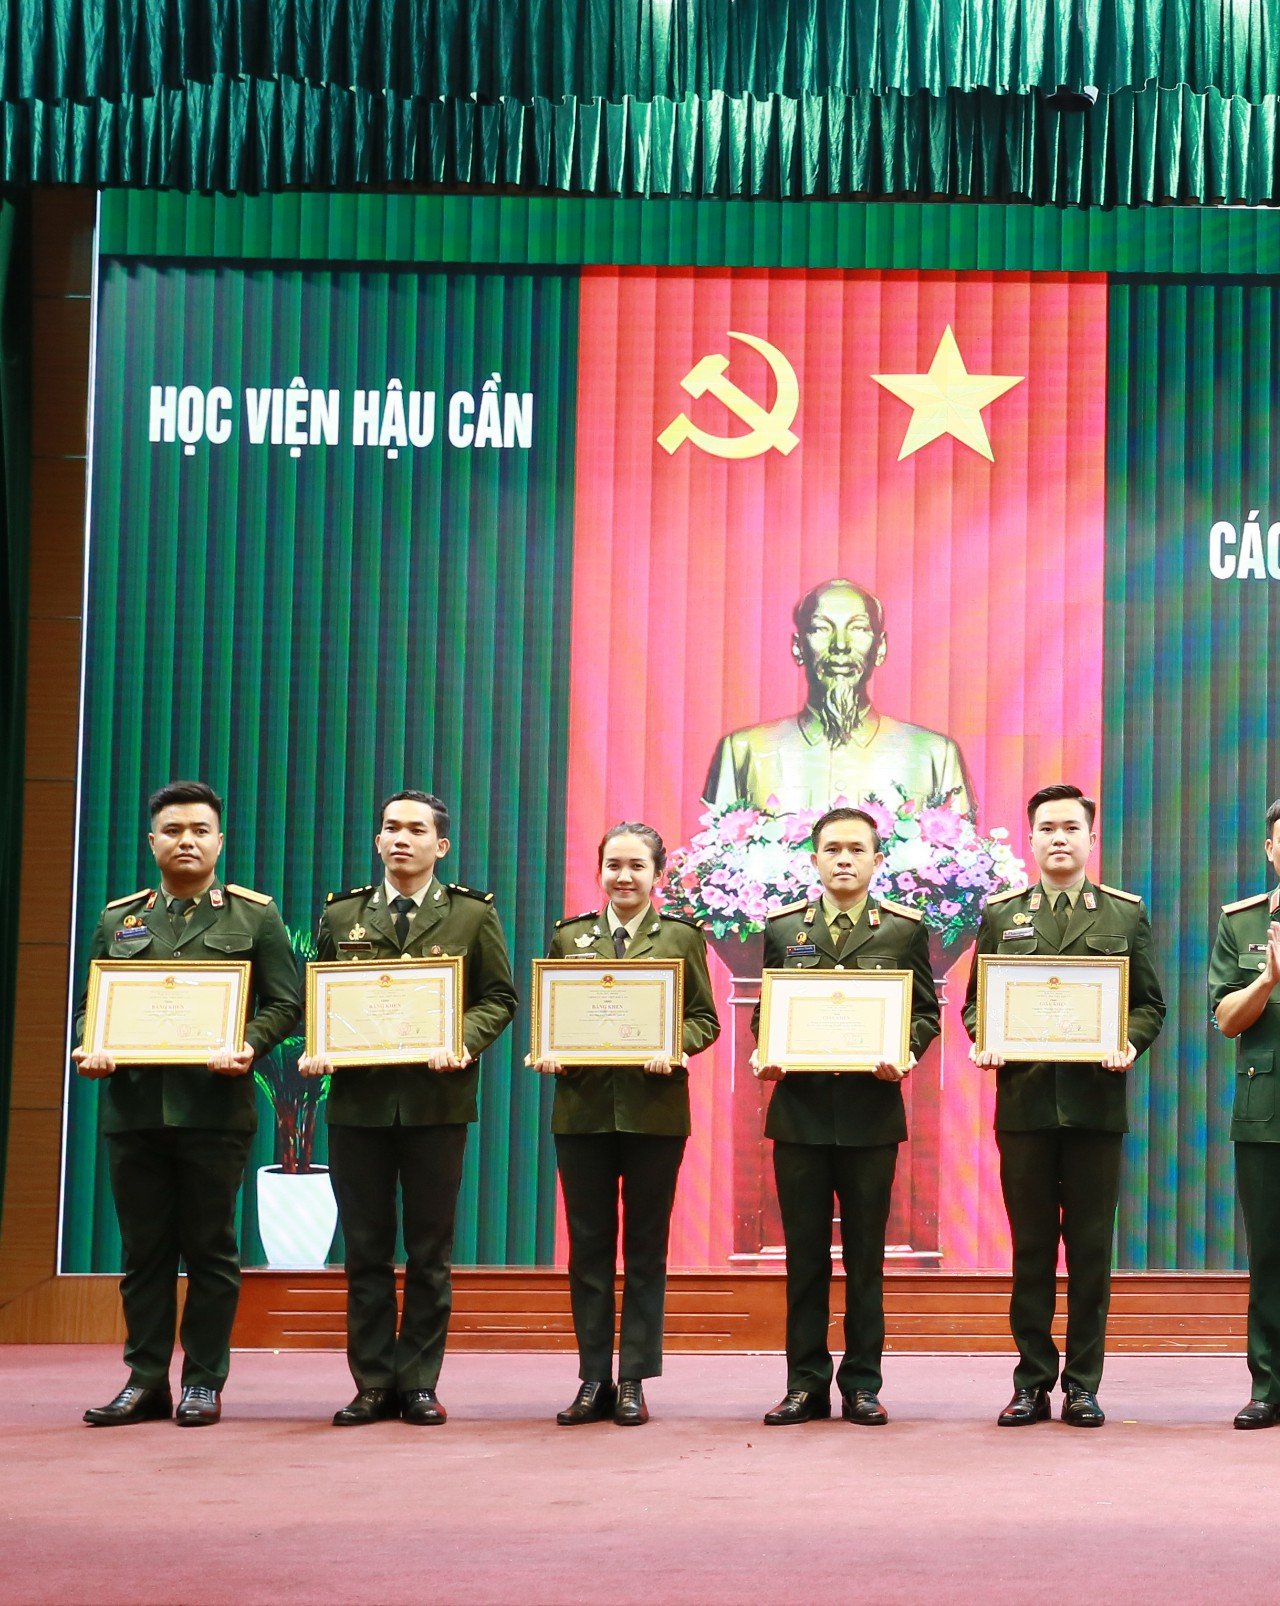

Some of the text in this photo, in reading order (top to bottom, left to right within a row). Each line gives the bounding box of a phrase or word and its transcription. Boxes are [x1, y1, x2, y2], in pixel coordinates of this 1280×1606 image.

[149, 372, 534, 460] HỌC VIỆN HẬU CẦN
